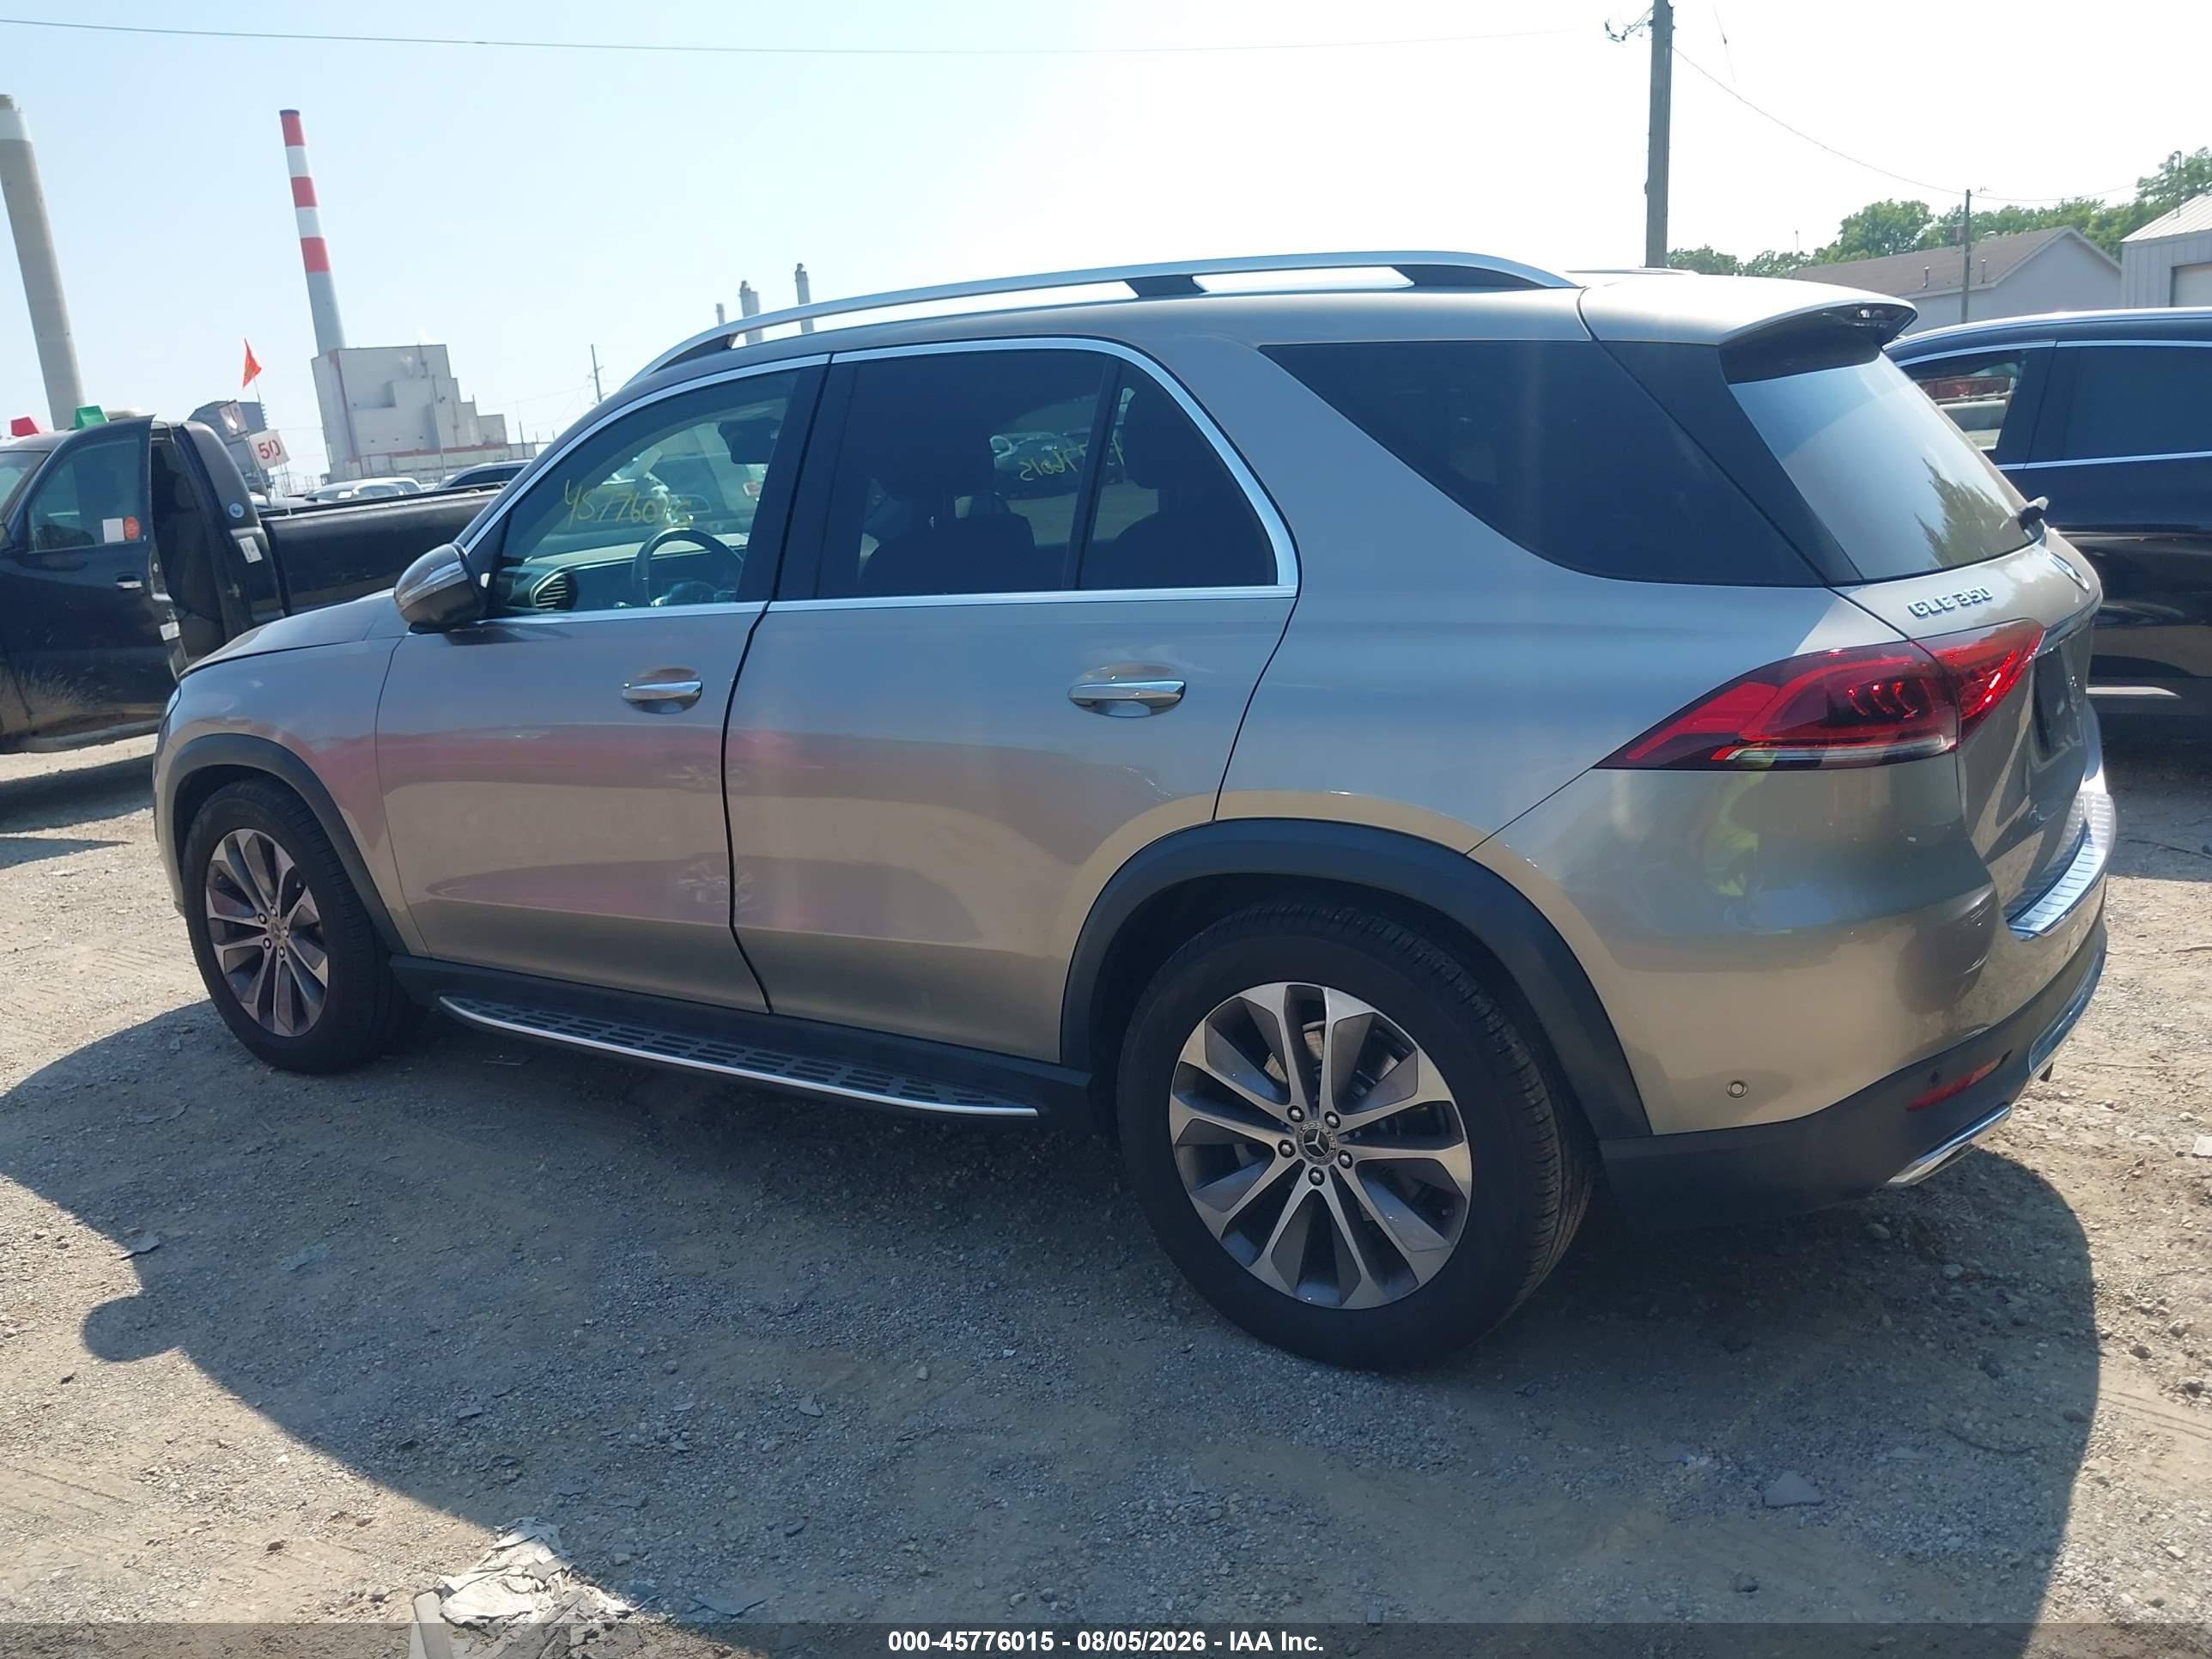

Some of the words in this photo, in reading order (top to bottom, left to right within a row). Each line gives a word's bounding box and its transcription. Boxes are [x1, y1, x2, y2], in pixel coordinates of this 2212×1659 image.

[257, 439, 282, 460] 50
[1906, 595, 1956, 617] GLE
[1952, 586, 1994, 607] 350
